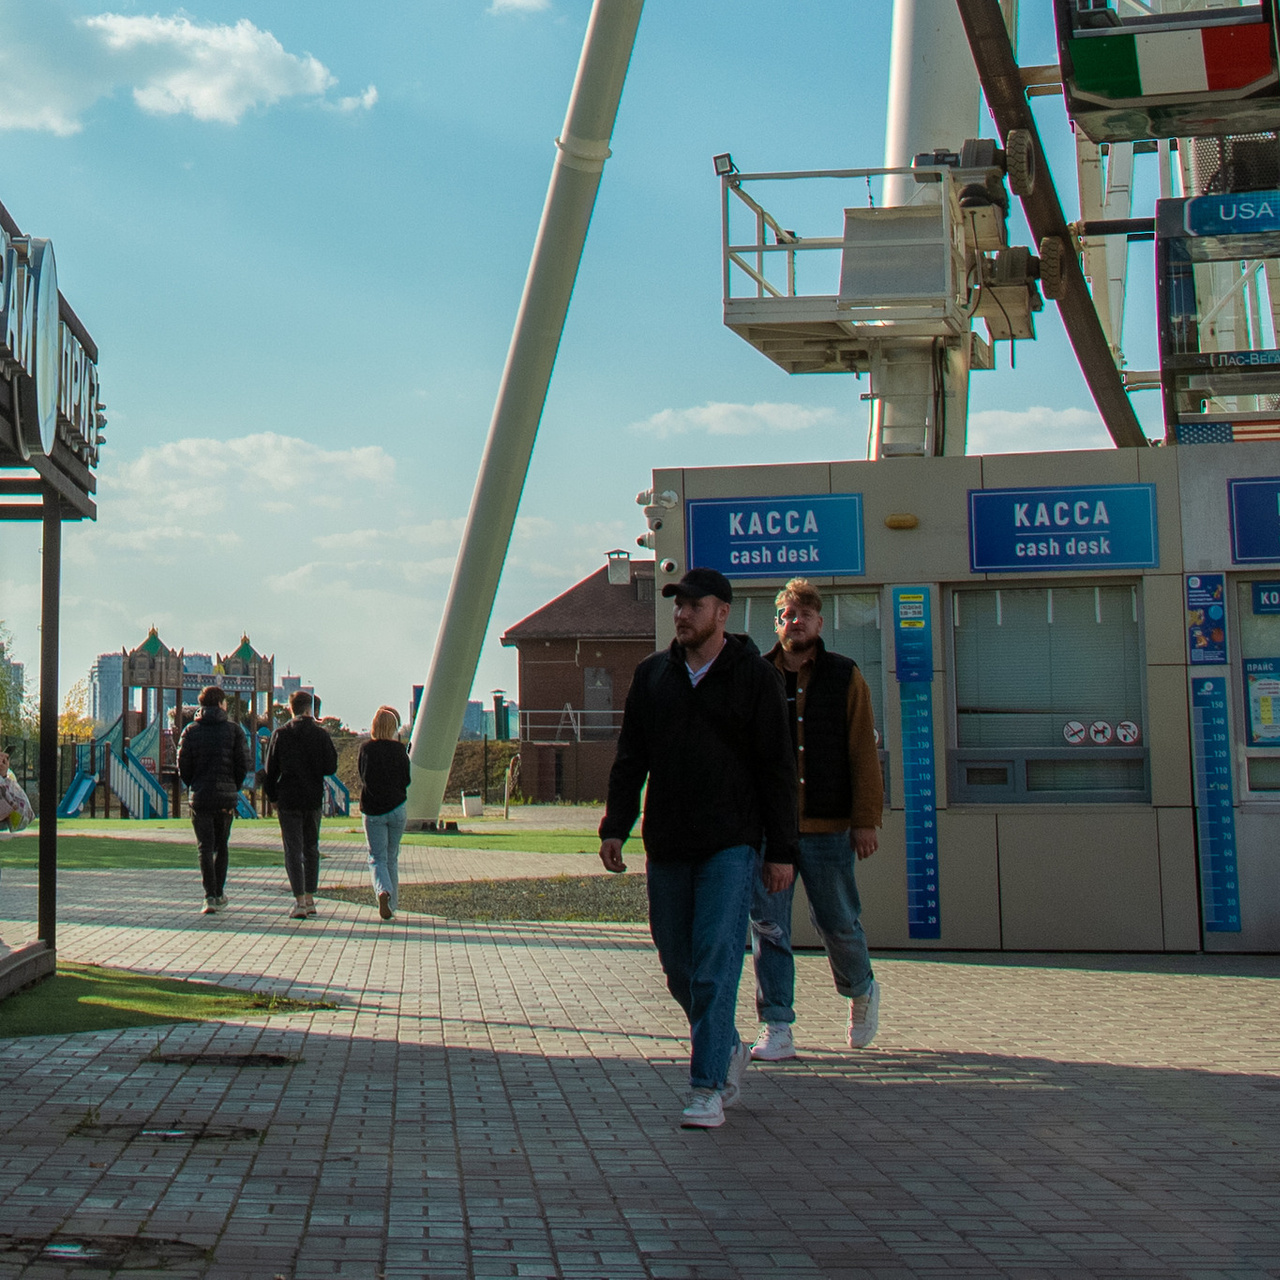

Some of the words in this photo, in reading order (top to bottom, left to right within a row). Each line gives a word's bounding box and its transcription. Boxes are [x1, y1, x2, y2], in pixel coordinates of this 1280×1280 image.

[1220, 201, 1275, 221] USA
[1014, 500, 1110, 527] КАССА
[729, 510, 819, 536] КАССА
[1015, 538, 1060, 556] cash
[1065, 536, 1111, 554] desk
[730, 546, 772, 564] cash
[777, 545, 819, 563] desk
[1246, 661, 1274, 671] ПРАЙС
[925, 836, 933, 844] 70
[1223, 832, 1231, 840] 70
[925, 852, 934, 860] 60
[1224, 849, 1232, 857] 60
[1225, 865, 1234, 873] 50
[1226, 881, 1235, 889] 40
